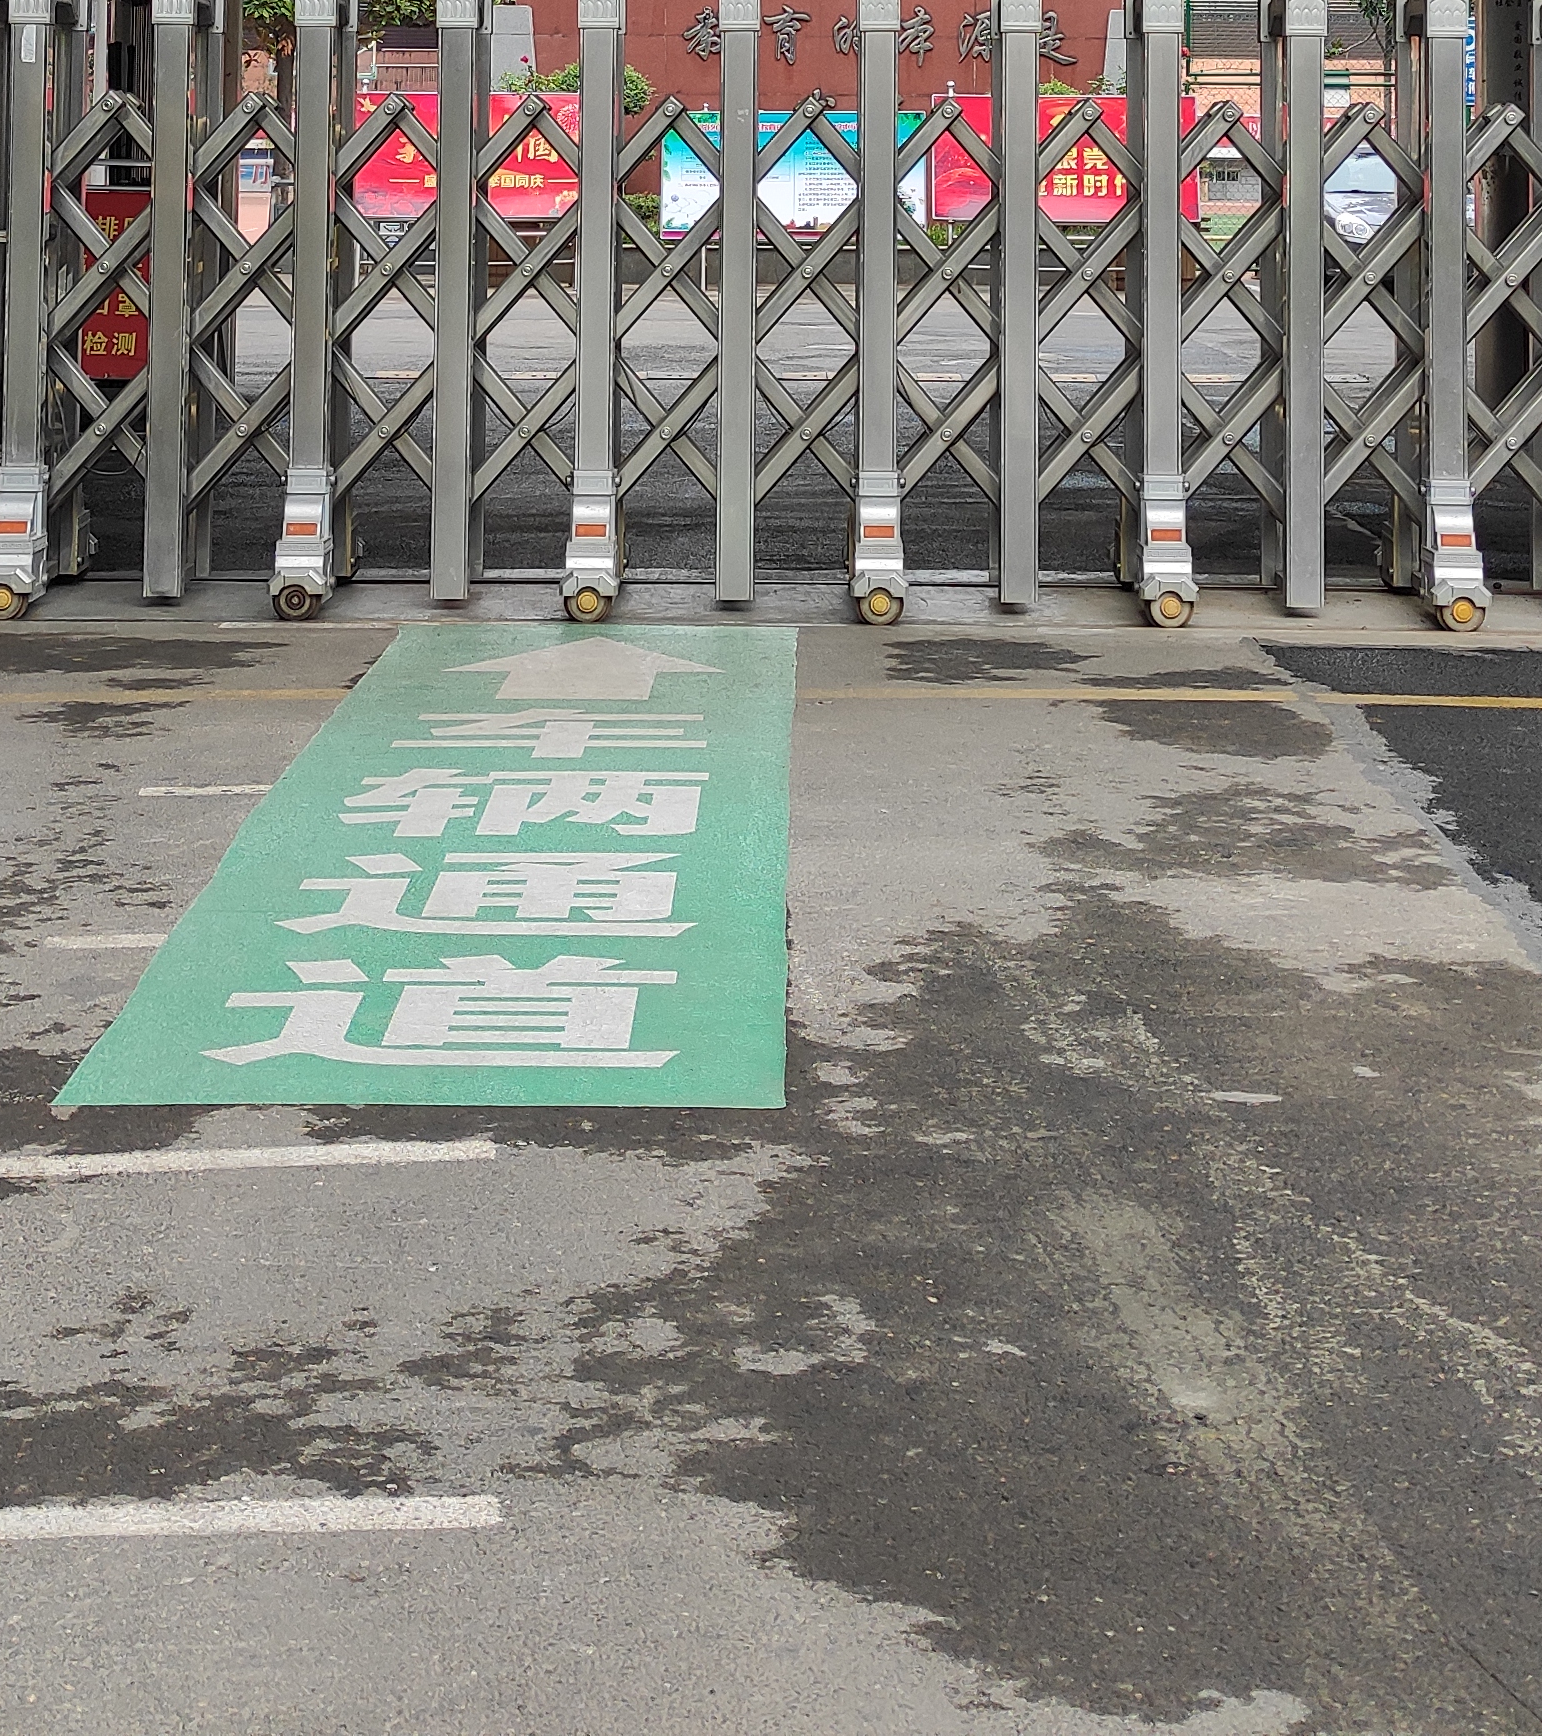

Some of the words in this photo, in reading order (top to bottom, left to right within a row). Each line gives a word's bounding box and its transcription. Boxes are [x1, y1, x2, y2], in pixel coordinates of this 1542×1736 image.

[84, 331, 136, 356] 检测
[200, 709, 710, 1068] 车辆通道
